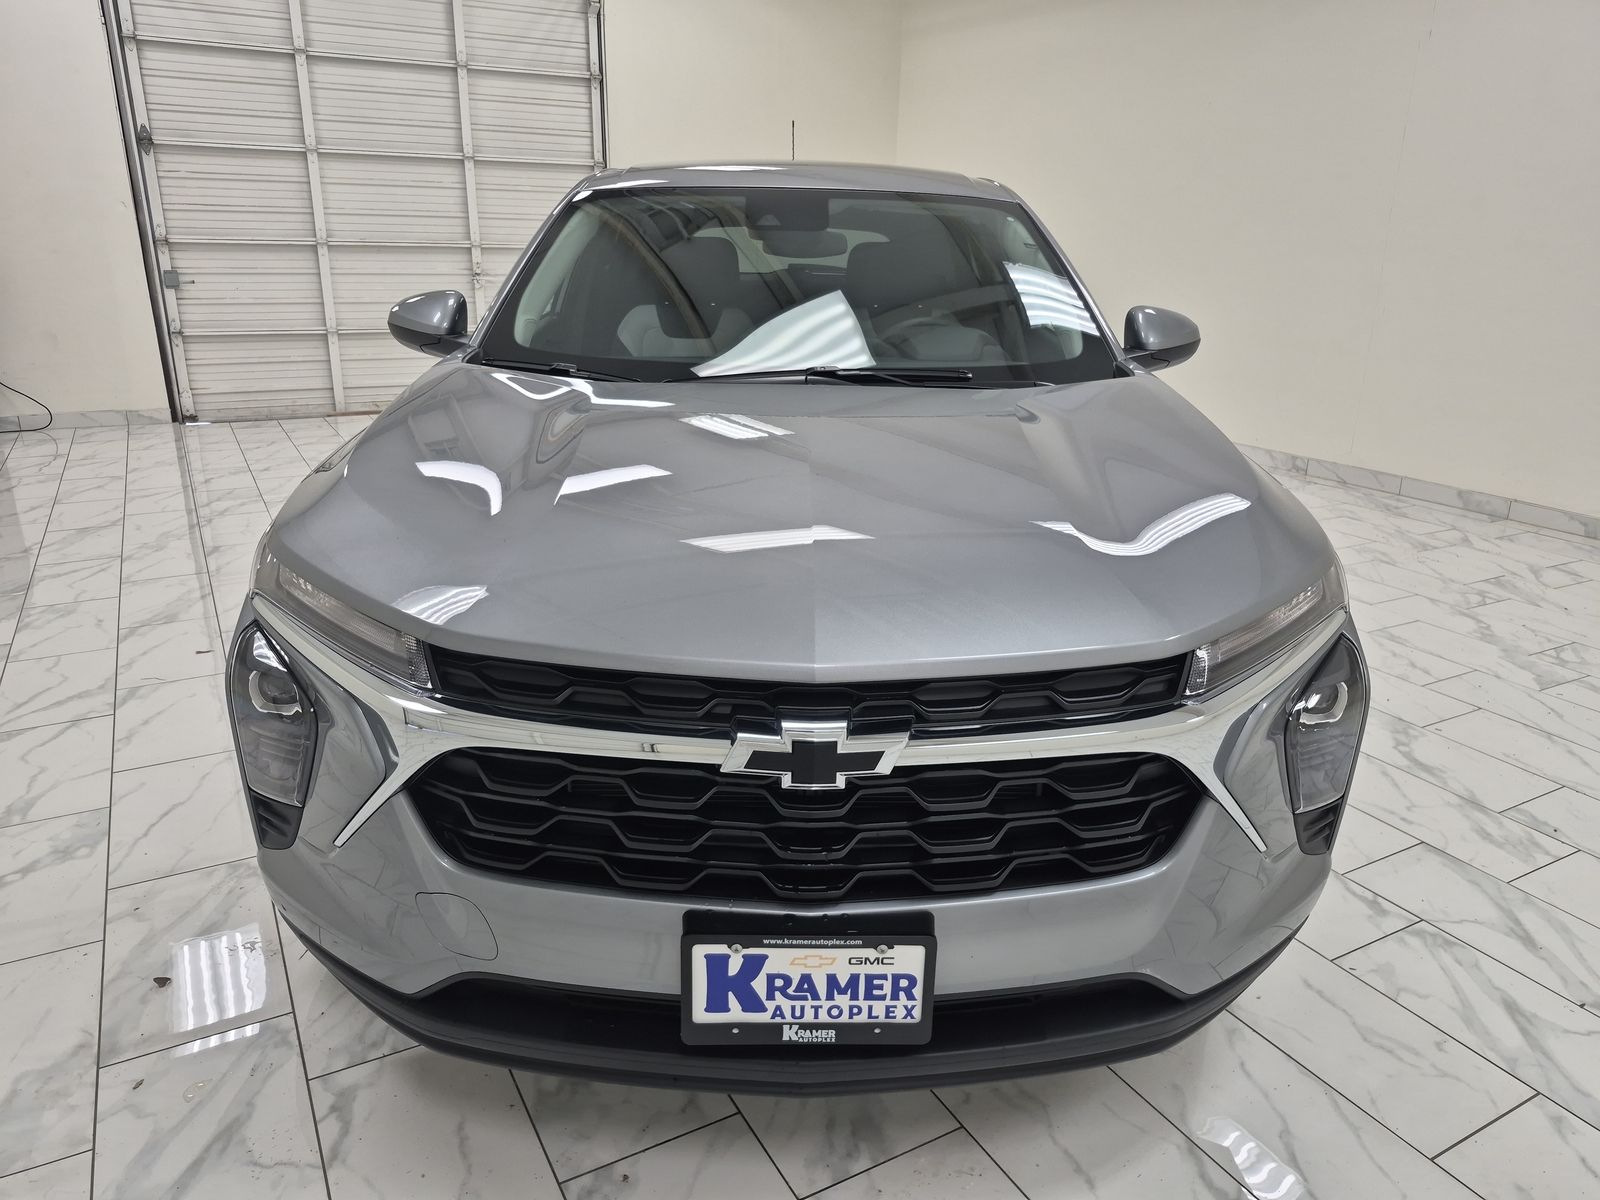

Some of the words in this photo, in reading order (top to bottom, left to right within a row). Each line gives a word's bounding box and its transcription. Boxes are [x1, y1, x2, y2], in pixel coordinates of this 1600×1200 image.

[763, 938, 863, 946] www.kramerautoplex.com
[848, 956, 895, 966] GMC
[704, 953, 918, 1014] KRAMER
[770, 1004, 917, 1020] AUTOPLEX
[782, 1024, 836, 1041] KRAMER
